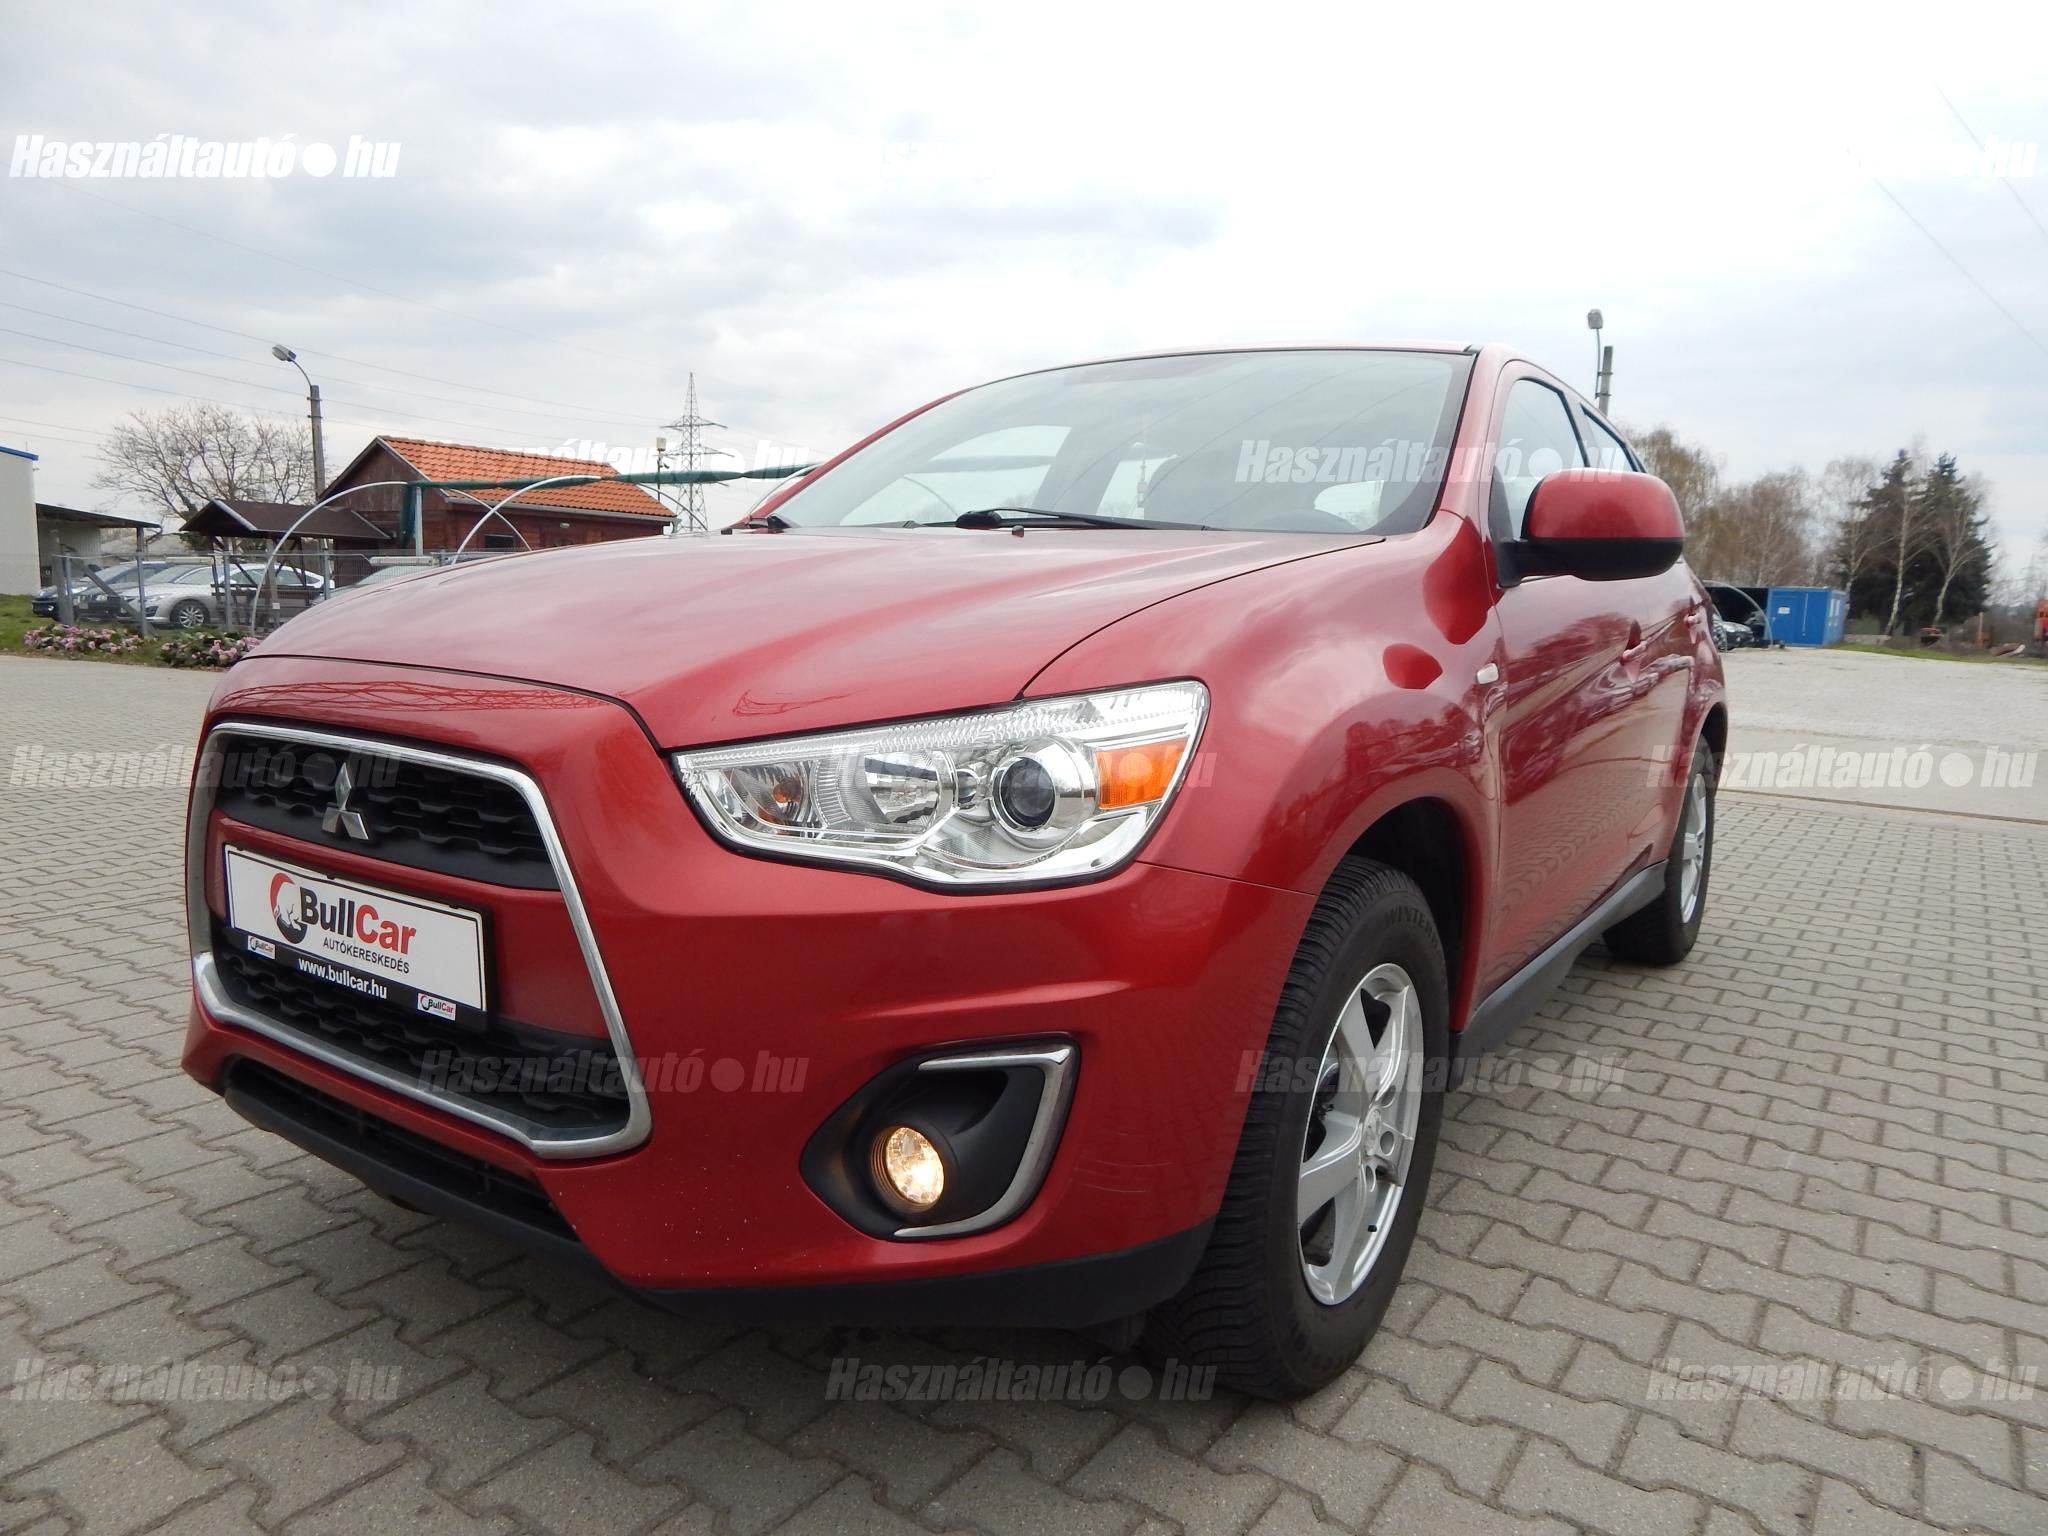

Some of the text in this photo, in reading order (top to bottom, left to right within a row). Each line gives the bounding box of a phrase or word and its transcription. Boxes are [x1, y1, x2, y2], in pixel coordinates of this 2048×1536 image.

[300, 887, 416, 955] BullCar
[323, 937, 410, 974] AUTÓKERESKEDÉS
[298, 957, 388, 999] www.bullcar.hu
[428, 998, 454, 1013] BullCar
